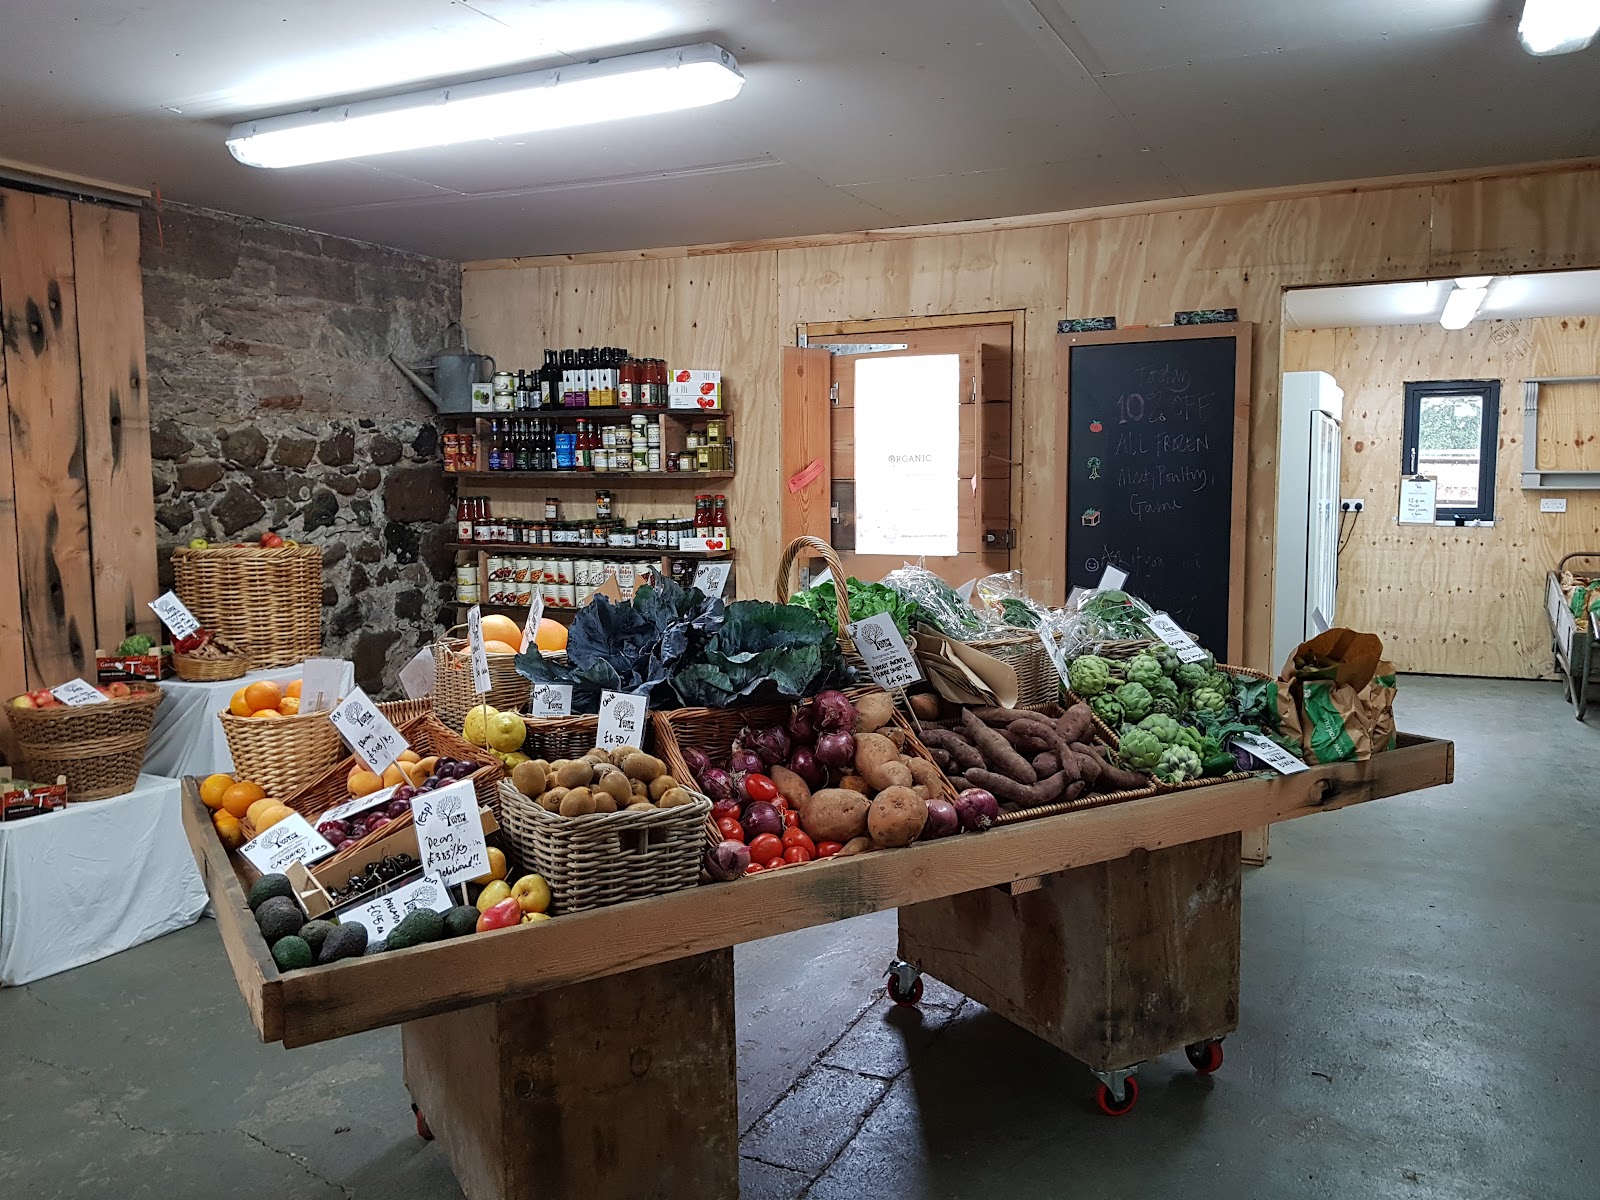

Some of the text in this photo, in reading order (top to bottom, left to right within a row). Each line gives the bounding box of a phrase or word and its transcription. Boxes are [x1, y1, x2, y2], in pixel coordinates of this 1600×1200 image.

[1133, 363, 1191, 393] Today
[1115, 431, 1210, 457] ALL FROZEN
[888, 454, 932, 463] ORGANIC
[1129, 493, 1183, 522] Game
